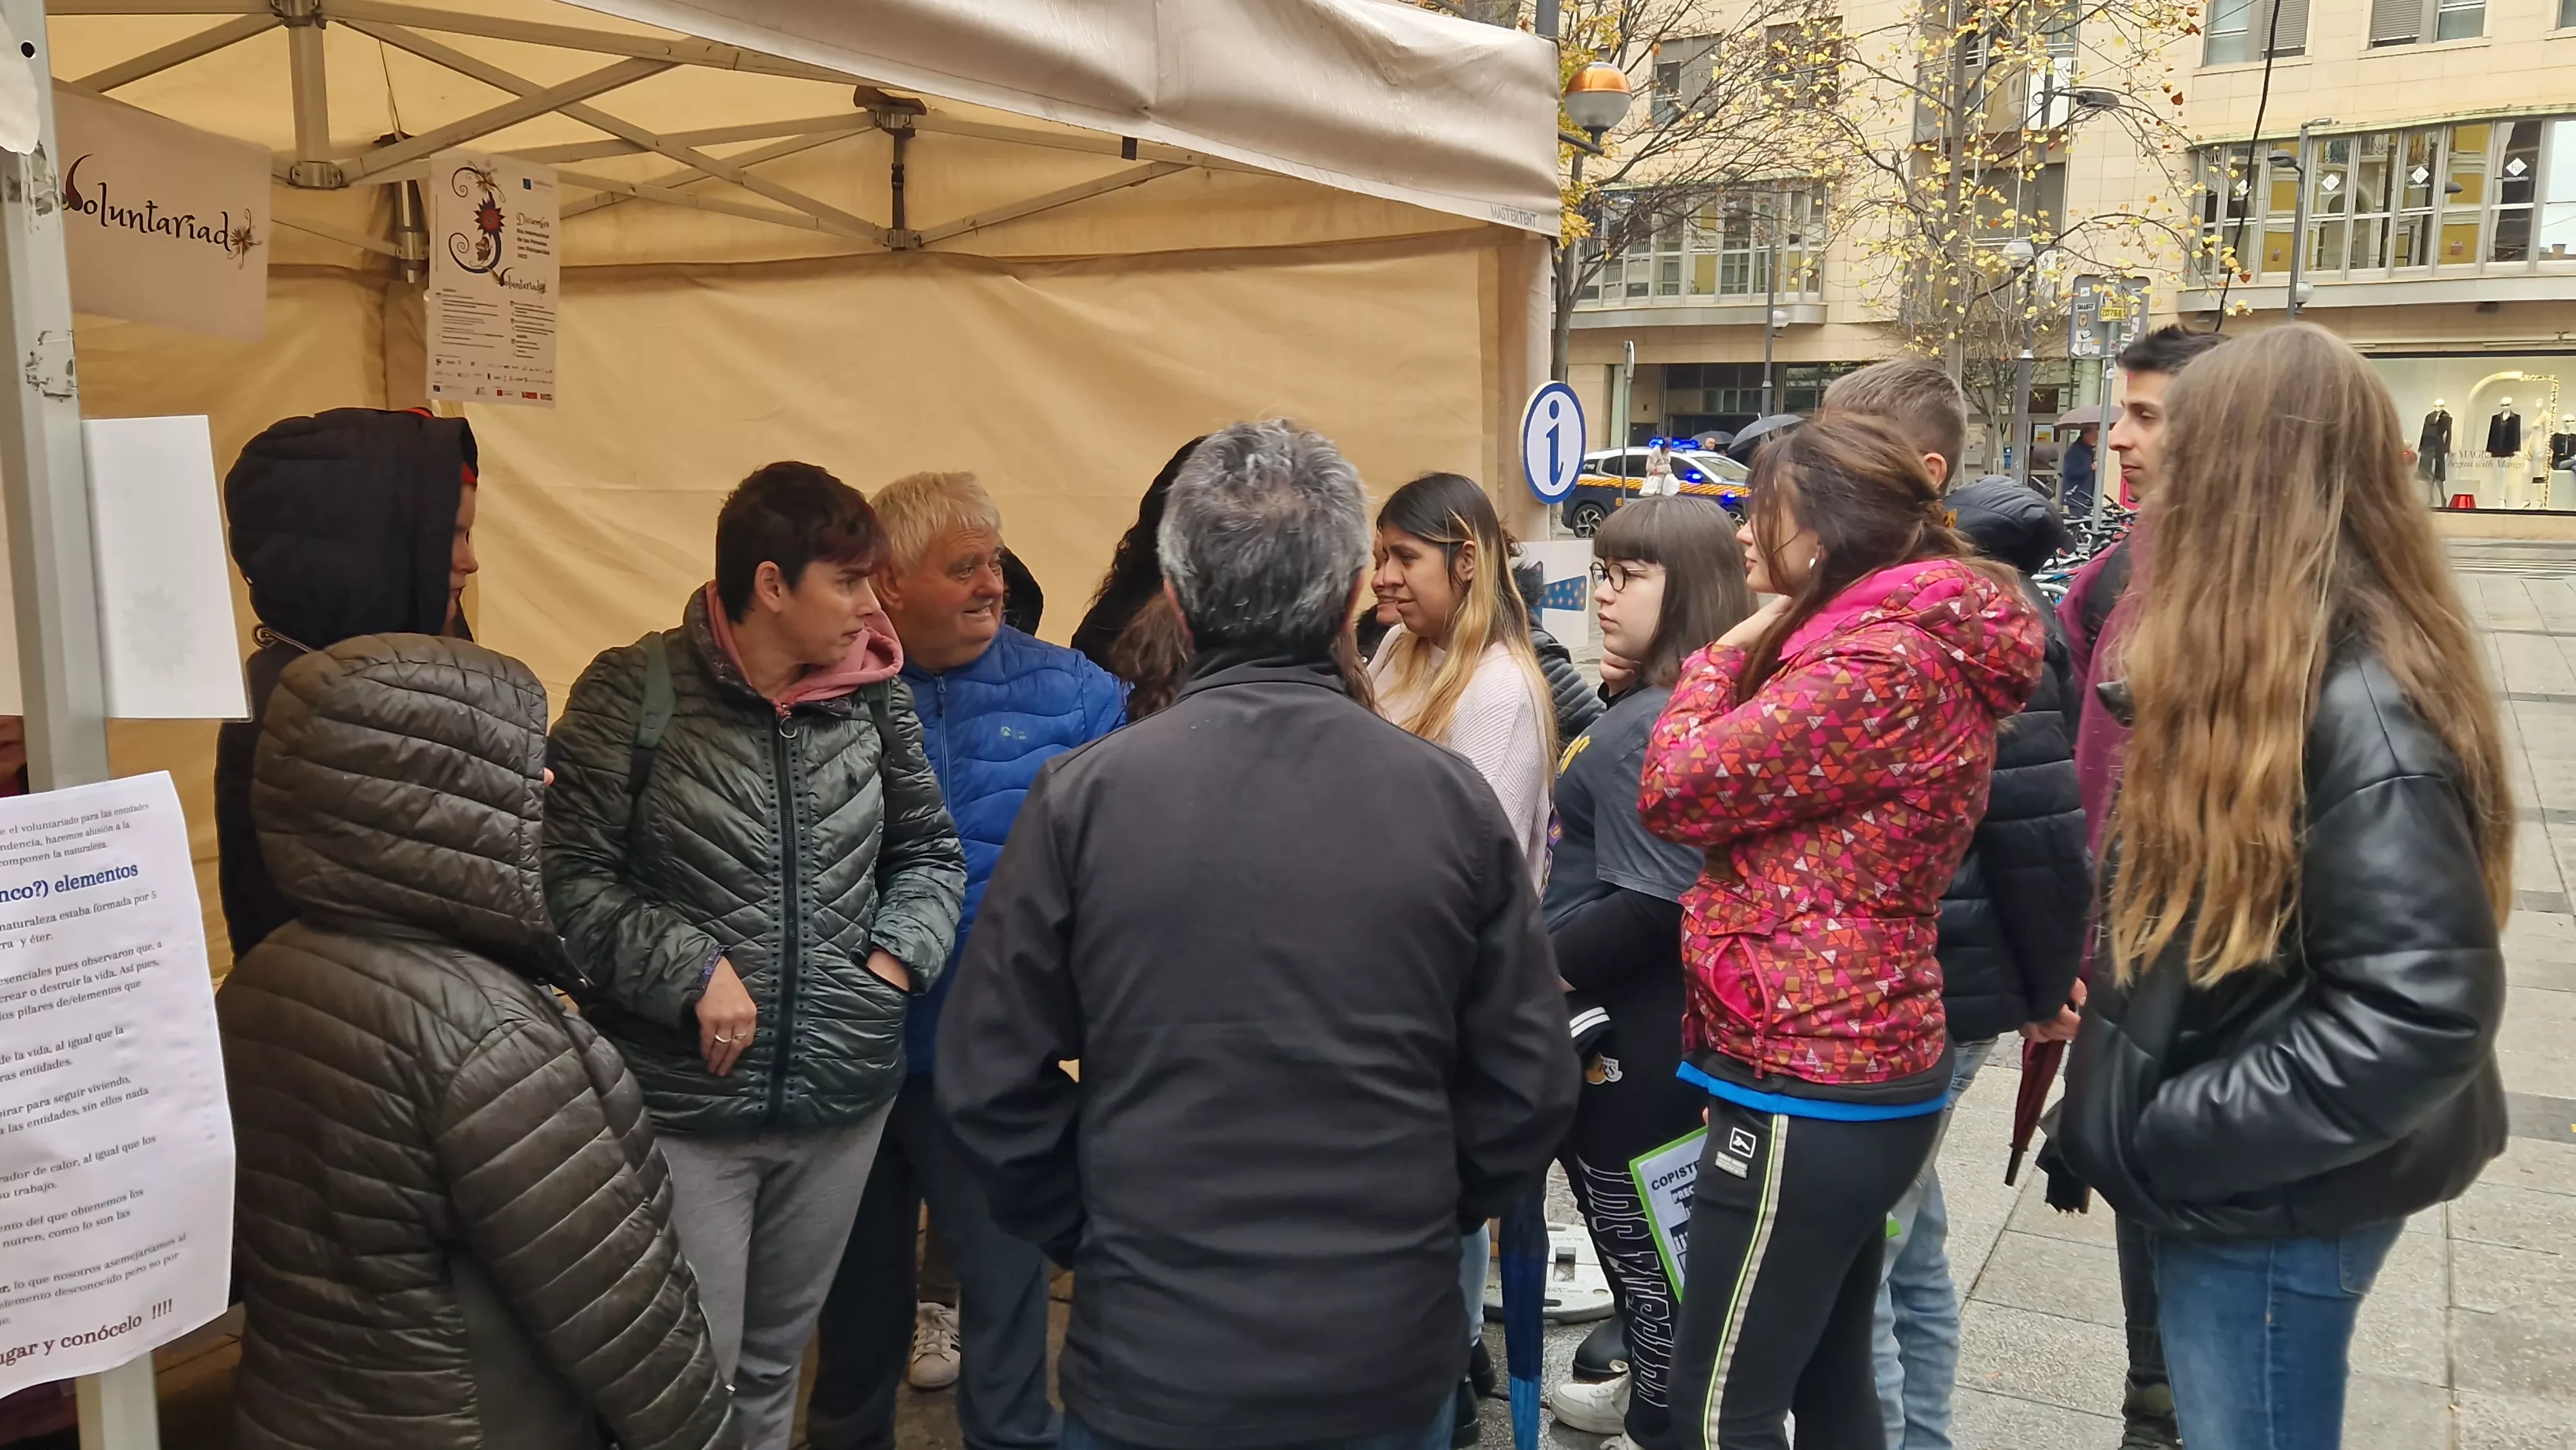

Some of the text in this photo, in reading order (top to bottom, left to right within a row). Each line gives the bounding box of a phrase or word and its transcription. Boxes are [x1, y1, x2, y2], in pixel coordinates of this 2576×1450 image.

[1490, 202, 1537, 227] MASTERTENT
[9, 825, 18, 834] el
[21, 817, 79, 833] voluntariado
[81, 813, 99, 824] para
[100, 809, 112, 819] las
[46, 831, 83, 845] haremos
[85, 825, 113, 837] alusión
[53, 850, 62, 858] la
[55, 864, 138, 892] elementos
[0, 890, 157, 932] naturaleza estaba formada por 5
[20, 938, 26, 948] y
[30, 932, 53, 944] éter.
[30, 988, 37, 997] o
[40, 977, 82, 995] destruir
[83, 975, 93, 984] la
[95, 969, 118, 981] vida.
[119, 963, 135, 975] Así
[136, 959, 160, 973] pues,
[55, 963, 79, 976] pues
[81, 948, 135, 967] observaron
[136, 943, 155, 956] que,
[17, 1001, 54, 1019] pilares
[56, 983, 122, 1008] de/elementos
[124, 980, 142, 992] que
[14, 1051, 24, 1061] la
[27, 1046, 53, 1058] vida,
[55, 1040, 64, 1051] al
[68, 1033, 92, 1050] igual
[95, 1031, 113, 1042] que
[115, 1026, 124, 1035] la
[19, 1057, 73, 1078] entidades.
[8, 1124, 24, 1134] las
[27, 1109, 79, 1128] entidades,
[82, 1102, 97, 1113] sin
[100, 1095, 122, 1108] ellos
[125, 1087, 149, 1101] nada
[26, 1098, 51, 1113] para
[53, 1088, 86, 1104] seguir
[88, 1075, 131, 1094] viviendo,
[33, 1166, 47, 1176] de
[50, 1158, 80, 1172] calor,
[82, 1153, 91, 1164] al
[95, 1145, 119, 1162] igual
[121, 1141, 140, 1154] que
[142, 1135, 156, 1146] los
[14, 1182, 57, 1197] trabajo.
[26, 1216, 44, 1227] del
[46, 1212, 68, 1225] que
[71, 1194, 128, 1216] obtenemos
[129, 1189, 144, 1200] los
[2, 1209, 131, 1248] nutren, como lo son las
[14, 1281, 24, 1290] lo
[28, 1277, 50, 1289] que
[53, 1265, 102, 1282] nosotros
[178, 1233, 186, 1242] al
[54, 1274, 122, 1297] desconocido
[125, 1266, 146, 1281] pero
[149, 1260, 161, 1270] no
[163, 1252, 179, 1266] por
[43, 1339, 55, 1356] y
[61, 1315, 142, 1349] conócelo
